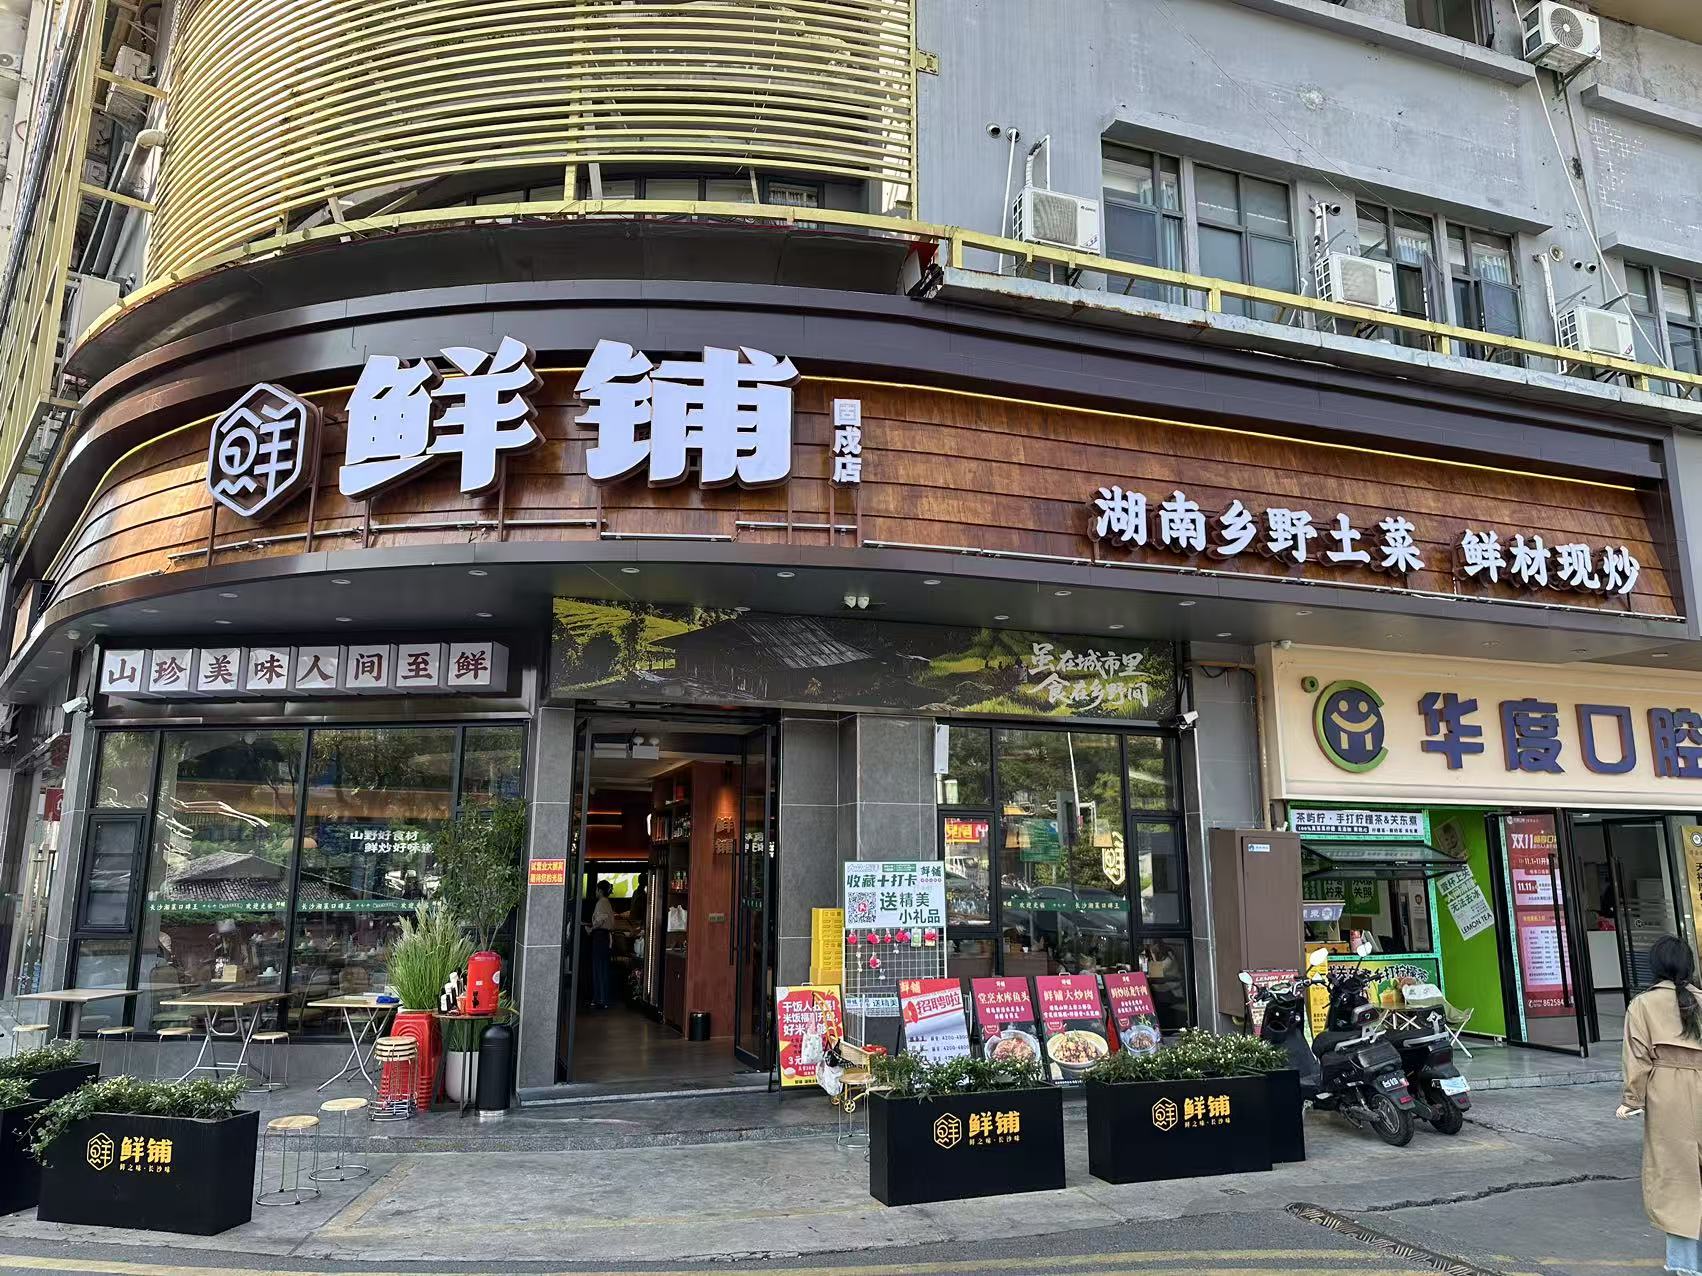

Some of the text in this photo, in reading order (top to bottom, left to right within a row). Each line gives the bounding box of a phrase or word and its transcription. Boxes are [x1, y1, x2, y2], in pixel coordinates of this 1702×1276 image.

[340, 335, 804, 494] 鲜铺
[833, 398, 863, 484] 固戍店
[1094, 485, 1640, 596] 湖南乡野土菜 鲜材现炒
[108, 650, 490, 687] 山珍美味人间至鲜
[1416, 691, 1702, 778] 华度口腔
[921, 866, 942, 877] 鲜铺
[880, 891, 930, 911] 送 精美
[899, 908, 941, 924] 小礼品
[1461, 912, 1493, 935] LEMON TEA
[916, 991, 962, 1016] 招聘啦
[1044, 989, 1094, 1002] 鲜铺大炒肉
[1183, 1095, 1231, 1121] 鲜铺
[969, 1111, 1020, 1137] 鲜铺
[120, 1136, 173, 1163] 鲜铺
